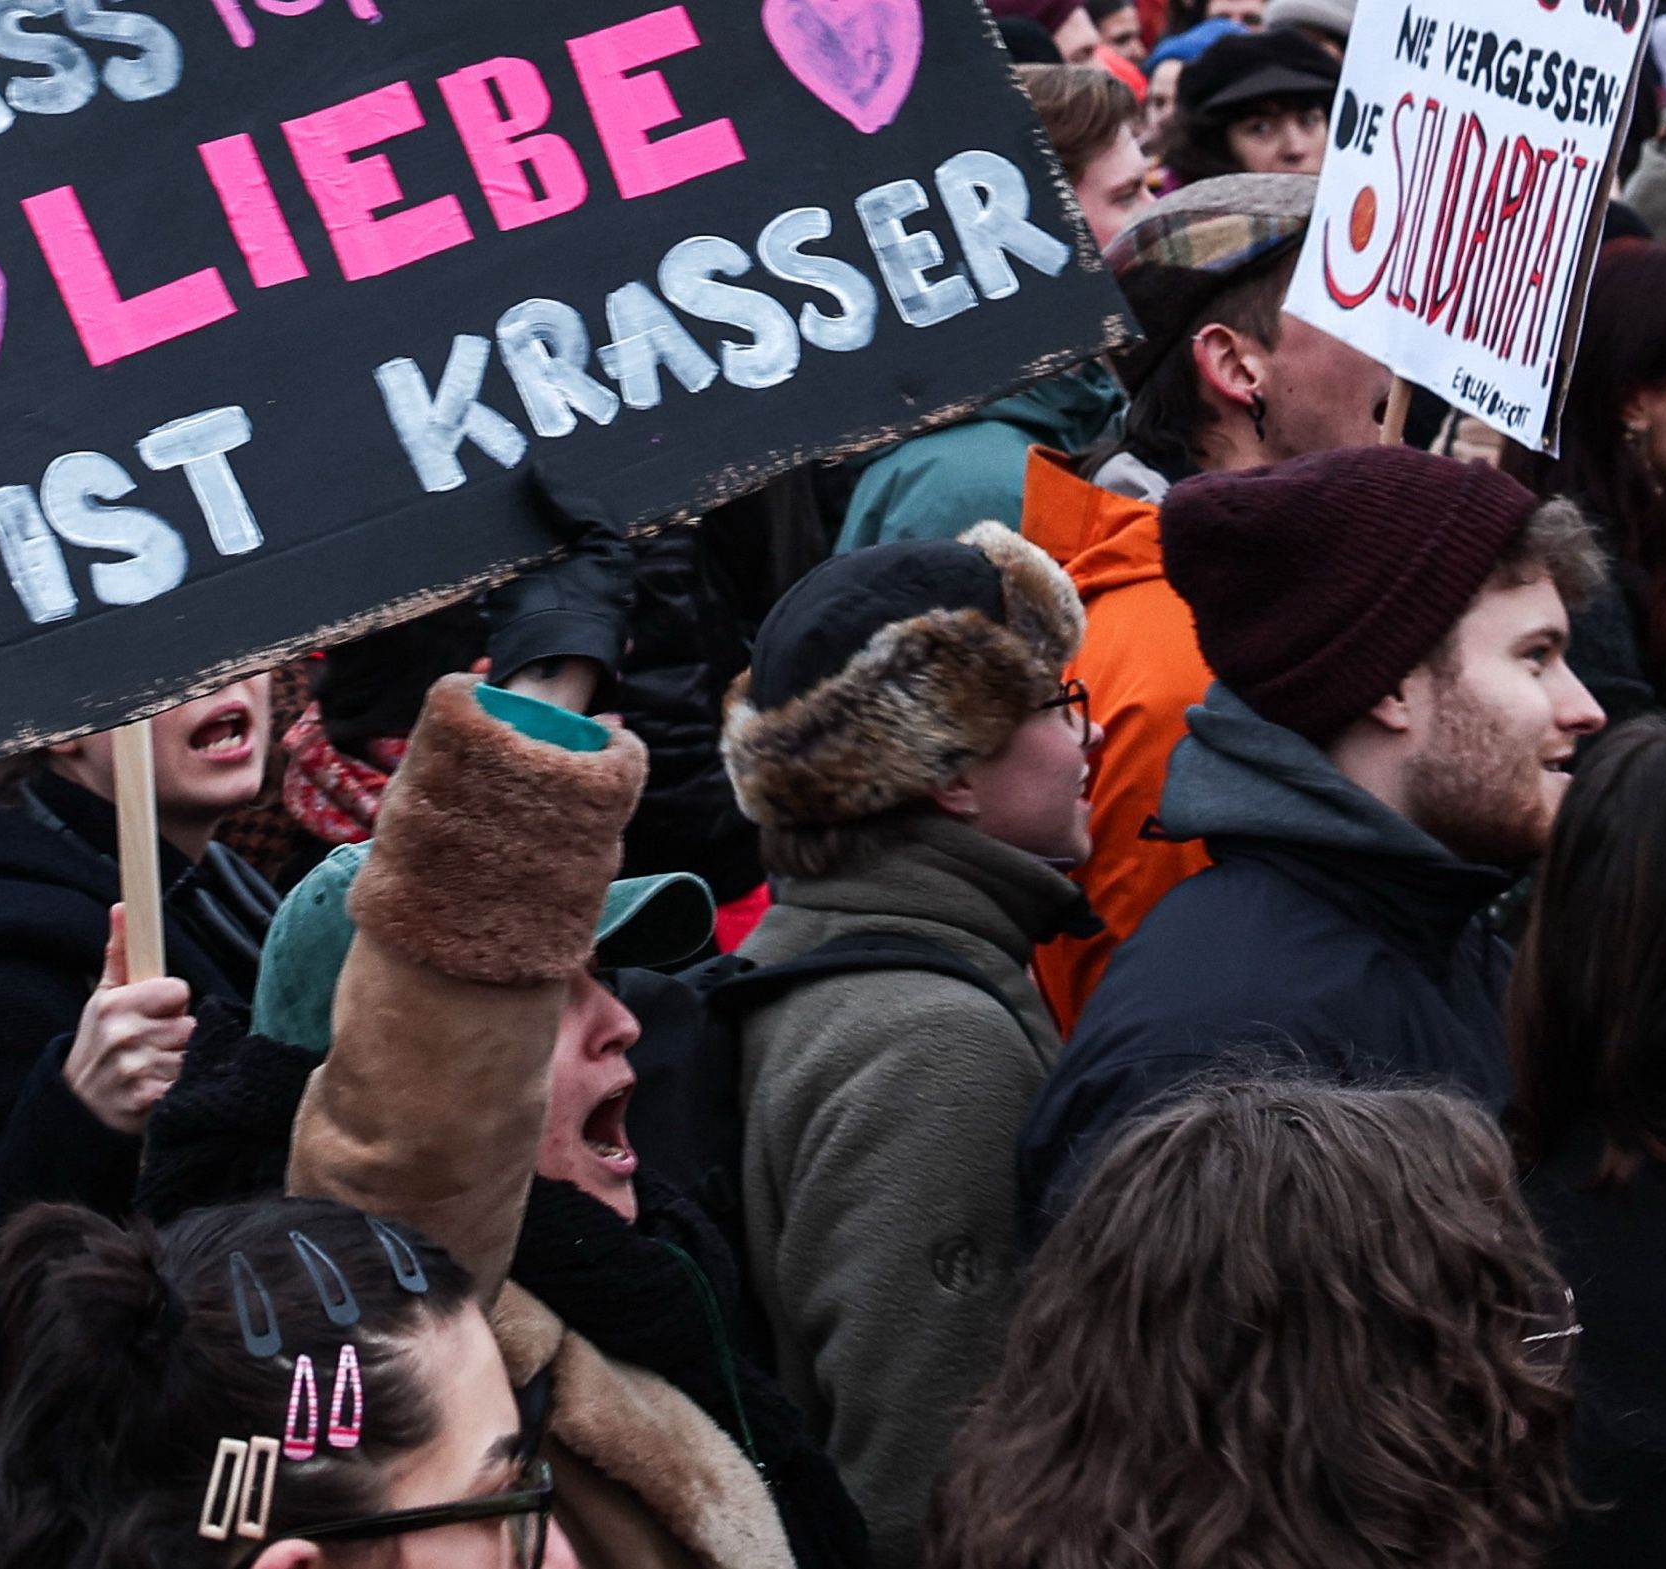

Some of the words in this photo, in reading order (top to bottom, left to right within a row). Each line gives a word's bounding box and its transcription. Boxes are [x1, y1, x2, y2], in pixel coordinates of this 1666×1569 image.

[1334, 88, 1384, 155] DIE
[1395, 3, 1438, 71] NIE
[1445, 22, 1620, 127] VERGESSEN:
[20, 4, 746, 368] LIEBE
[374, 149, 1071, 493] KRASSER
